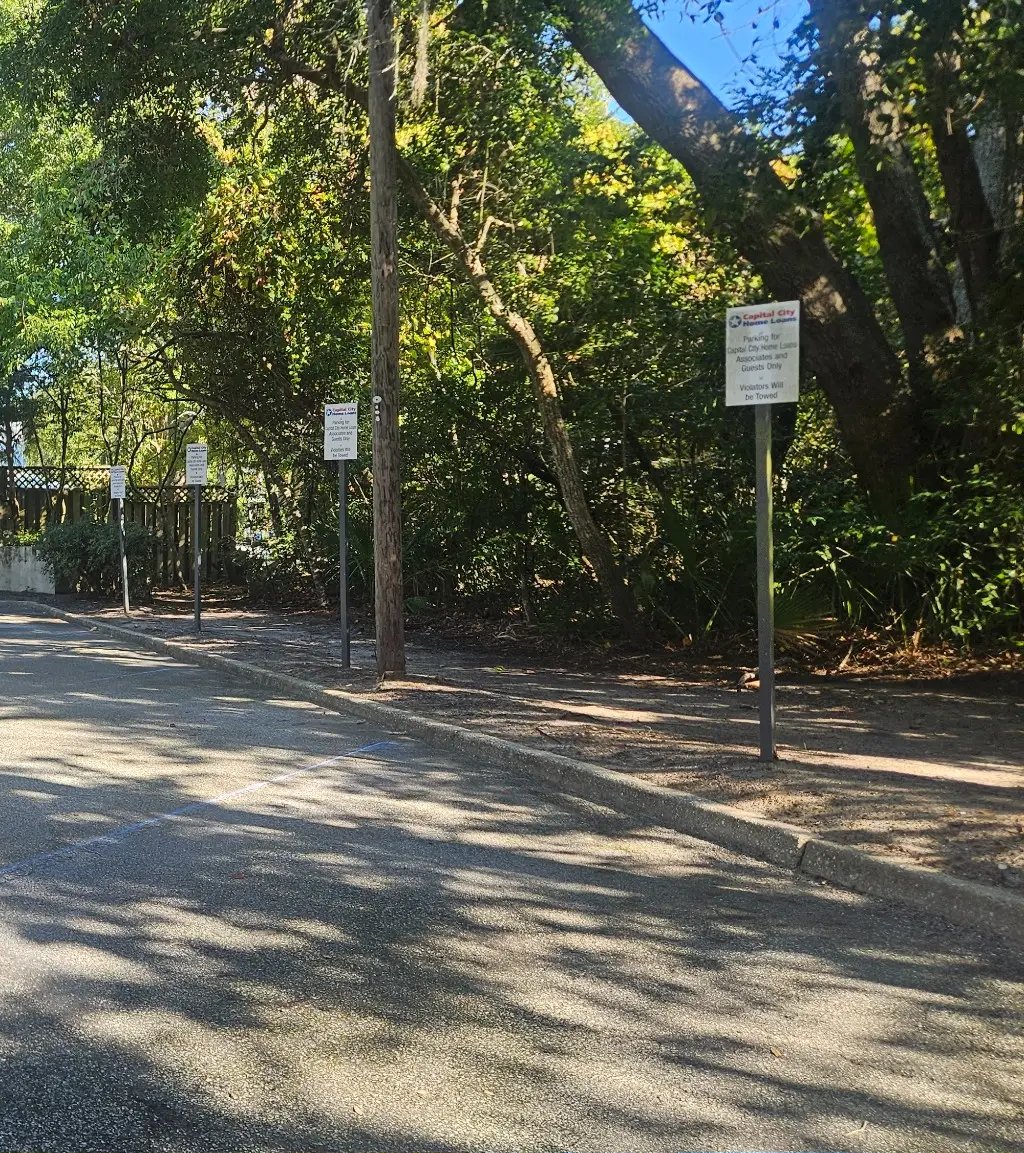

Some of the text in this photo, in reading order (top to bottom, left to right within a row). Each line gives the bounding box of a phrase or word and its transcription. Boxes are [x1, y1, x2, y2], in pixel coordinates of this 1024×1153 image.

[743, 308, 795, 320] Capital City
[743, 332, 780, 342] Parking for
[736, 352, 788, 363] Associates and
[741, 362, 782, 372] Guests Only
[739, 381, 784, 391] Violators Will
[756, 392, 778, 400] Towed
